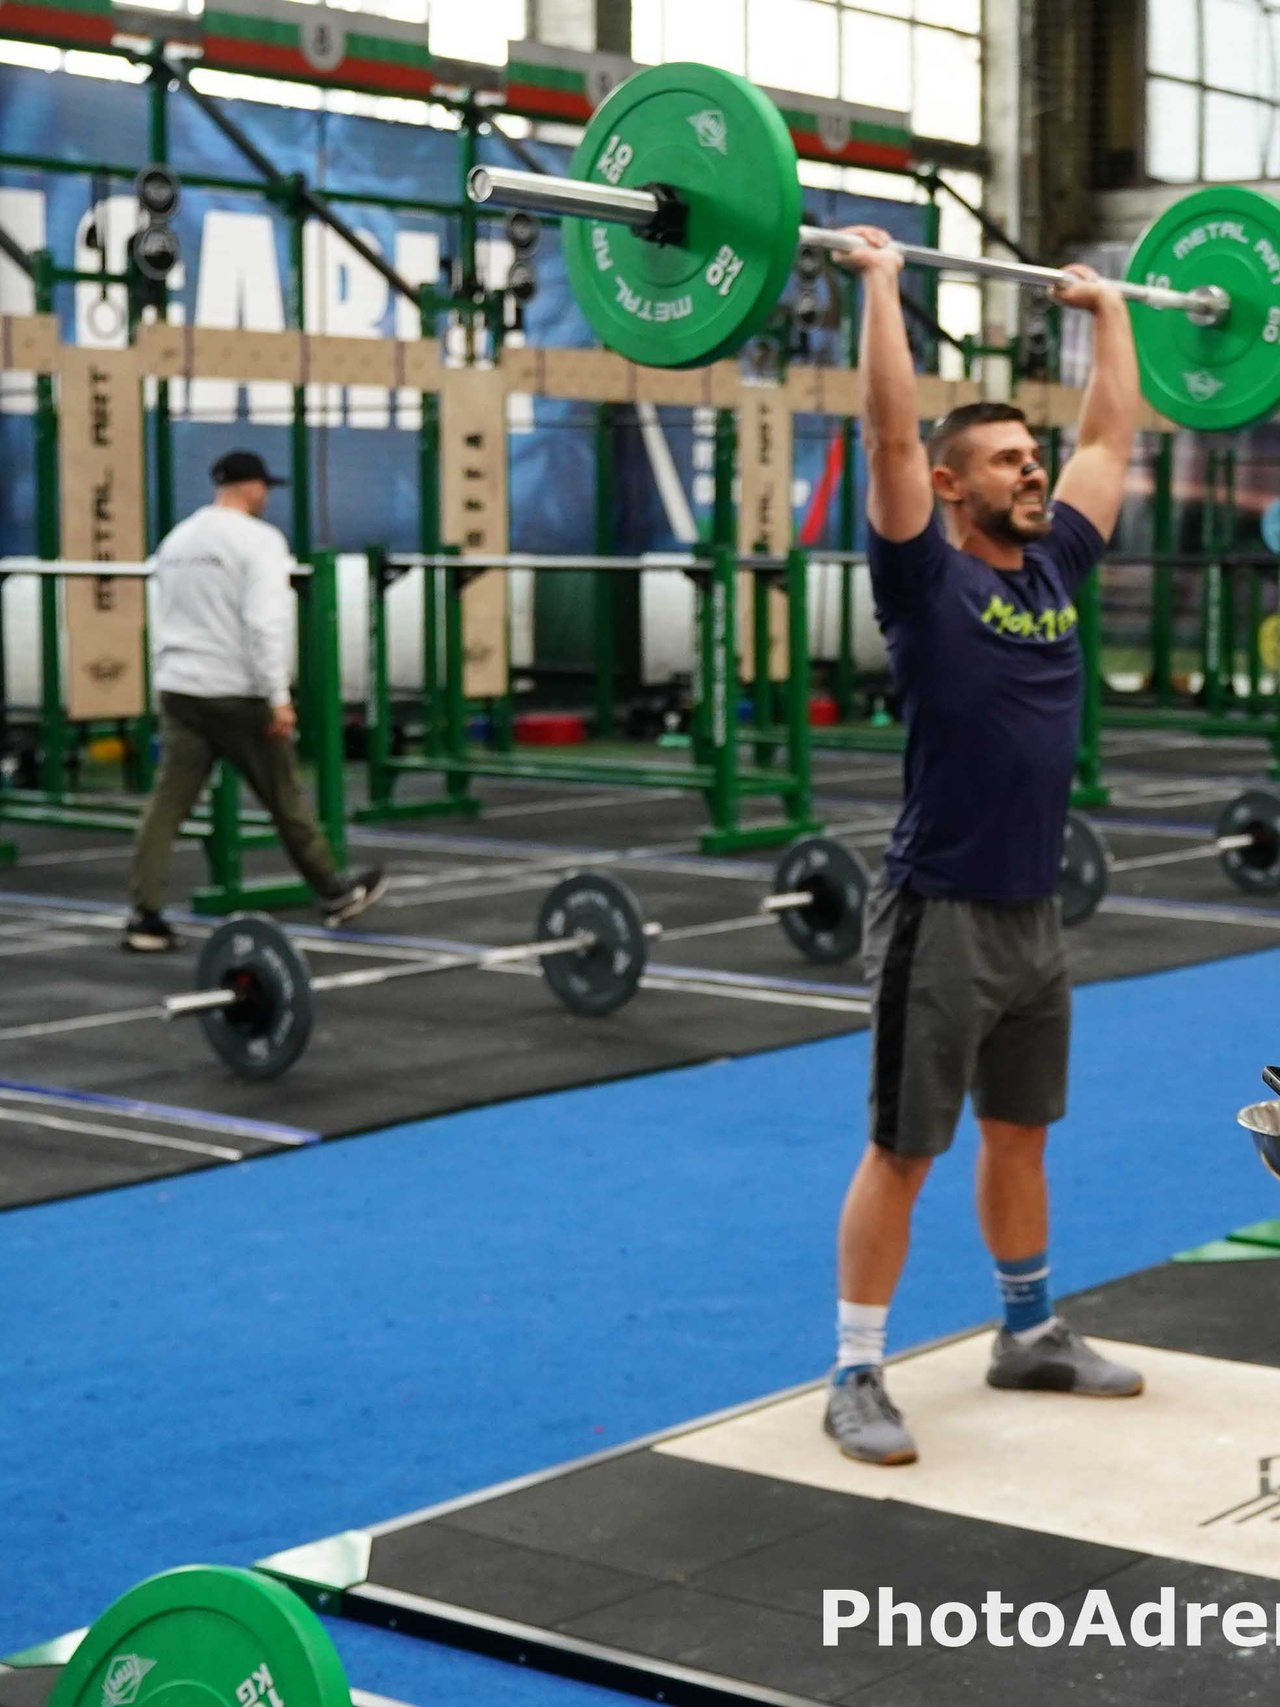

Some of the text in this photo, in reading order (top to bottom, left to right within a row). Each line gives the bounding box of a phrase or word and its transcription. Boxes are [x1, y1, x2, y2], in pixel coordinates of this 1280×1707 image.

[600, 134, 634, 166] 10
[596, 152, 624, 185] KG
[1173, 220, 1250, 260] METAL
[591, 220, 693, 322] METAL AR
[705, 262, 739, 296] 10
